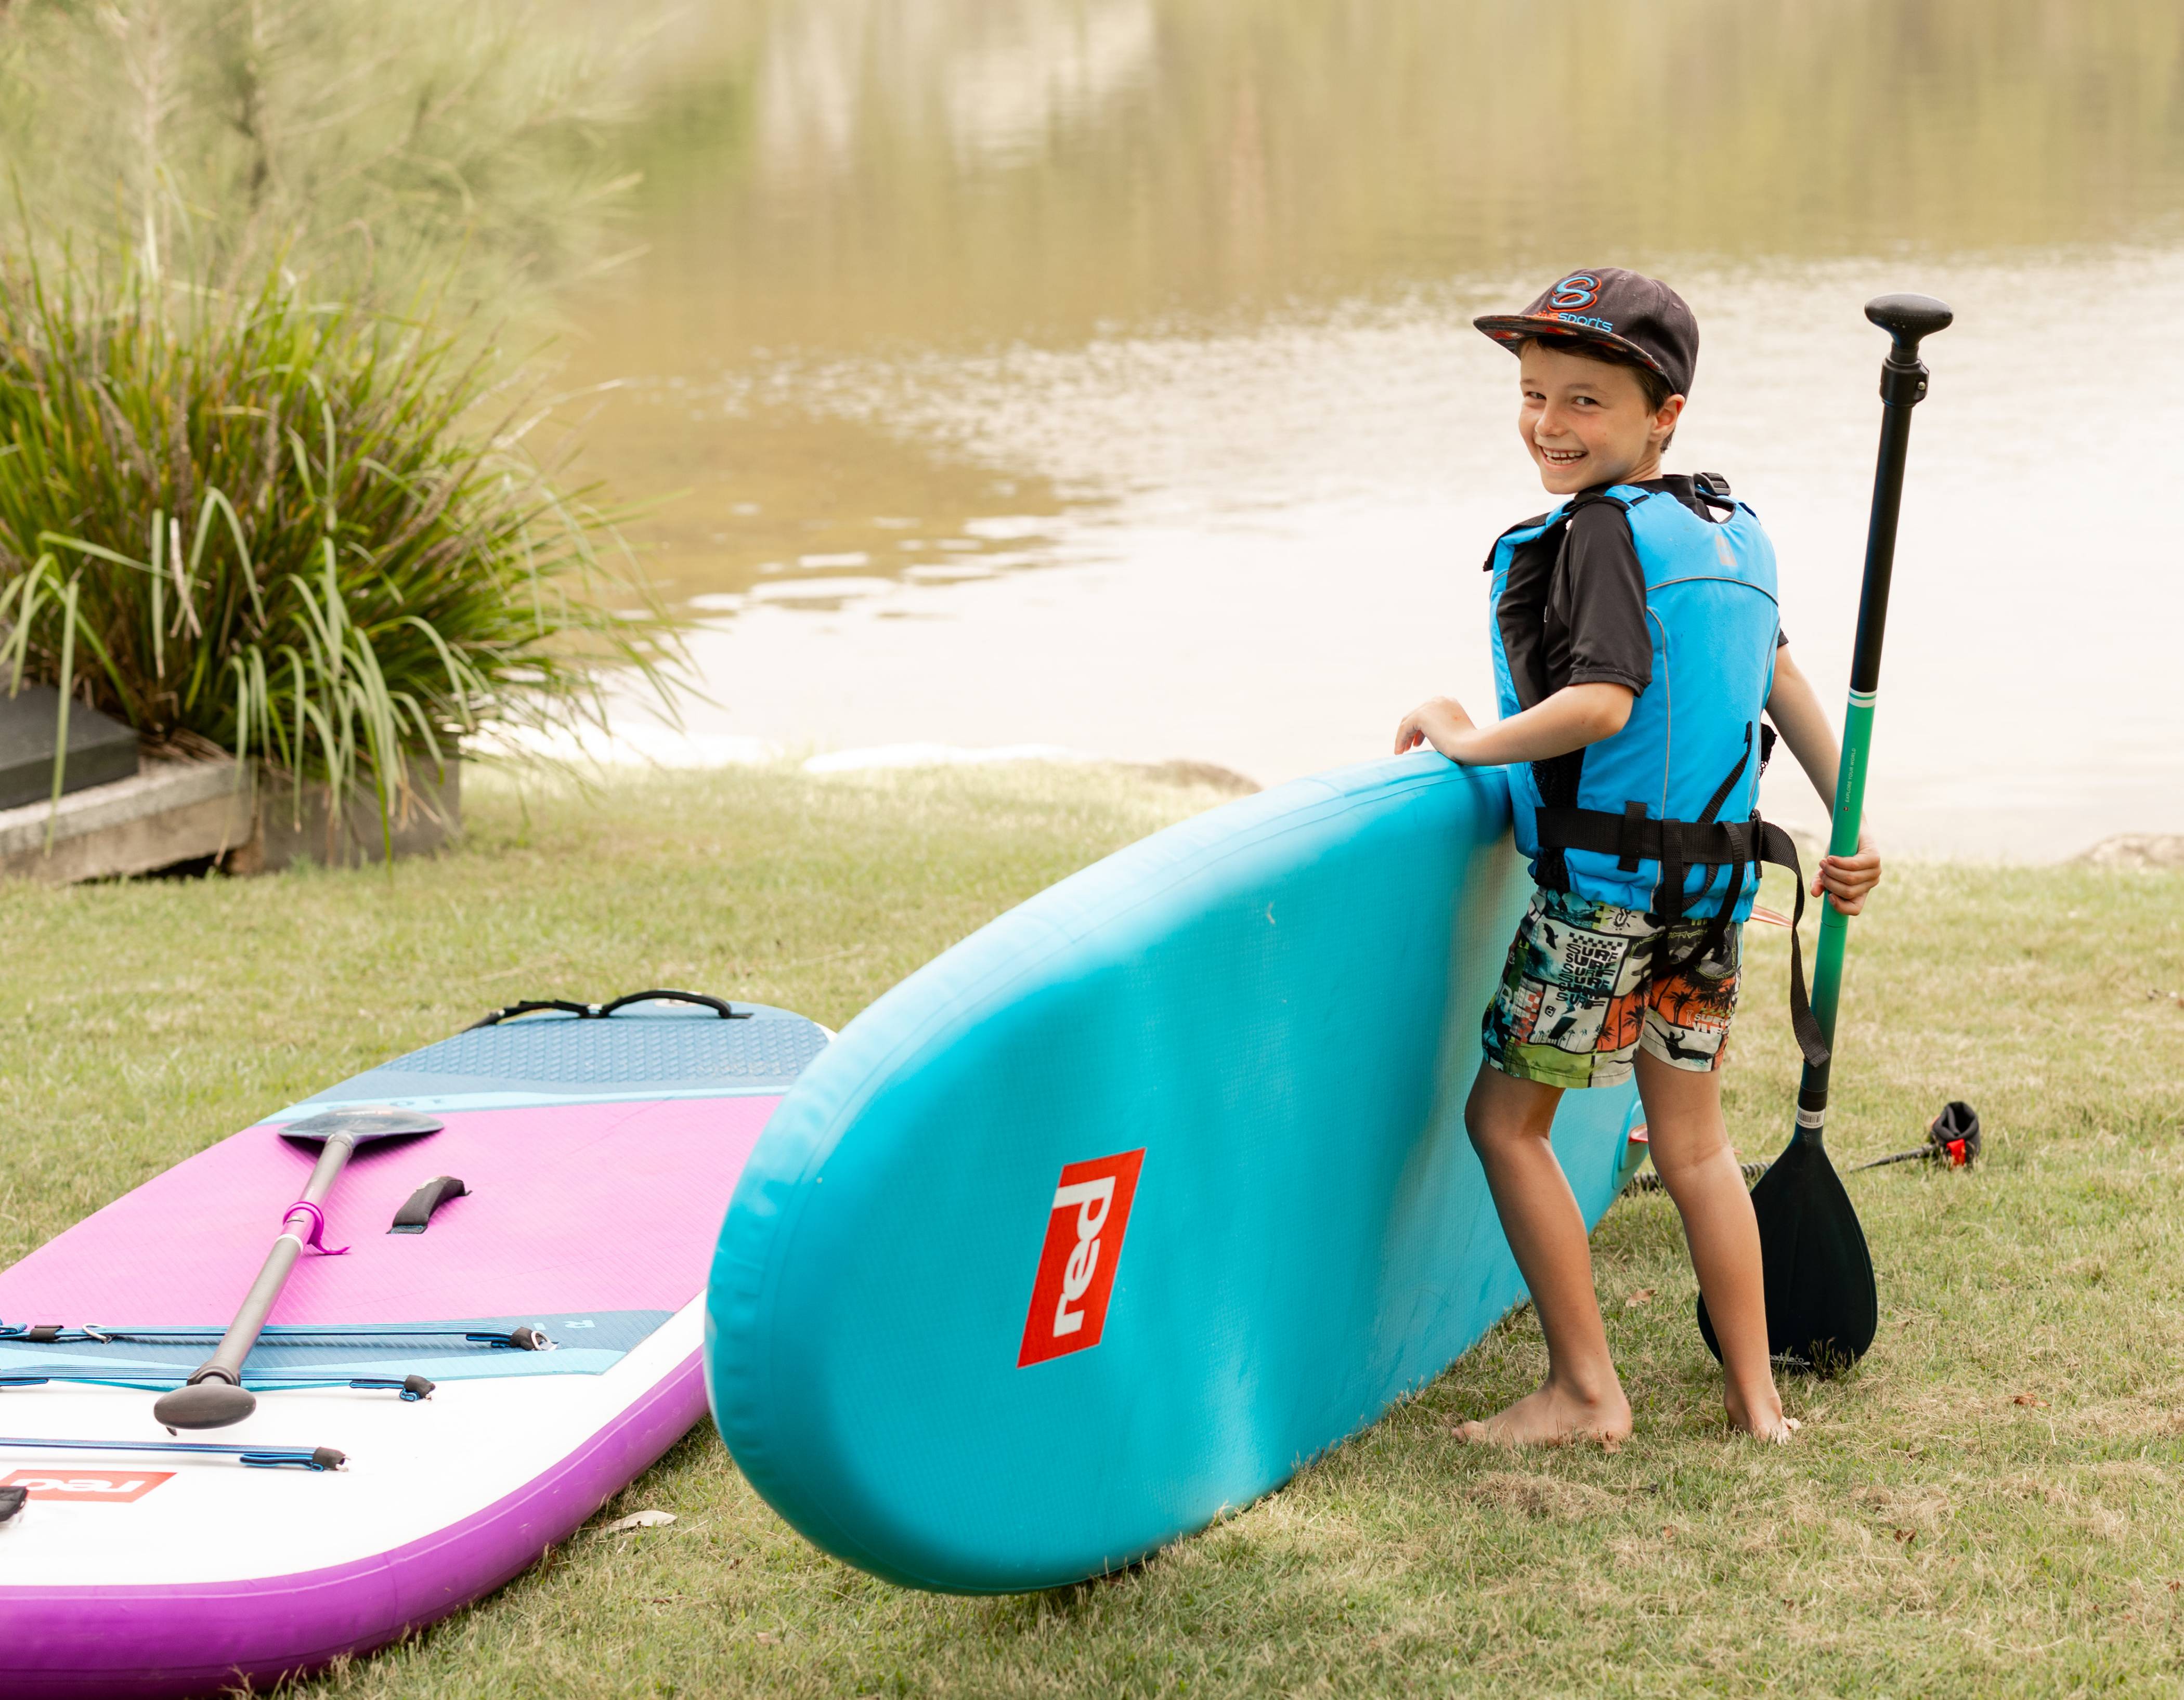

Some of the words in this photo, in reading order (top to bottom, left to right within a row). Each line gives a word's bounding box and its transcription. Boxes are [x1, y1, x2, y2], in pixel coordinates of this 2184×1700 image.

[1566, 943, 1618, 962] SURF
[1566, 952, 1616, 970] SURF
[1561, 963, 1616, 977] SURF
[1558, 973, 1610, 990] SURF
[1555, 992, 1606, 1010] SURF
[1052, 1175, 1116, 1338] red
